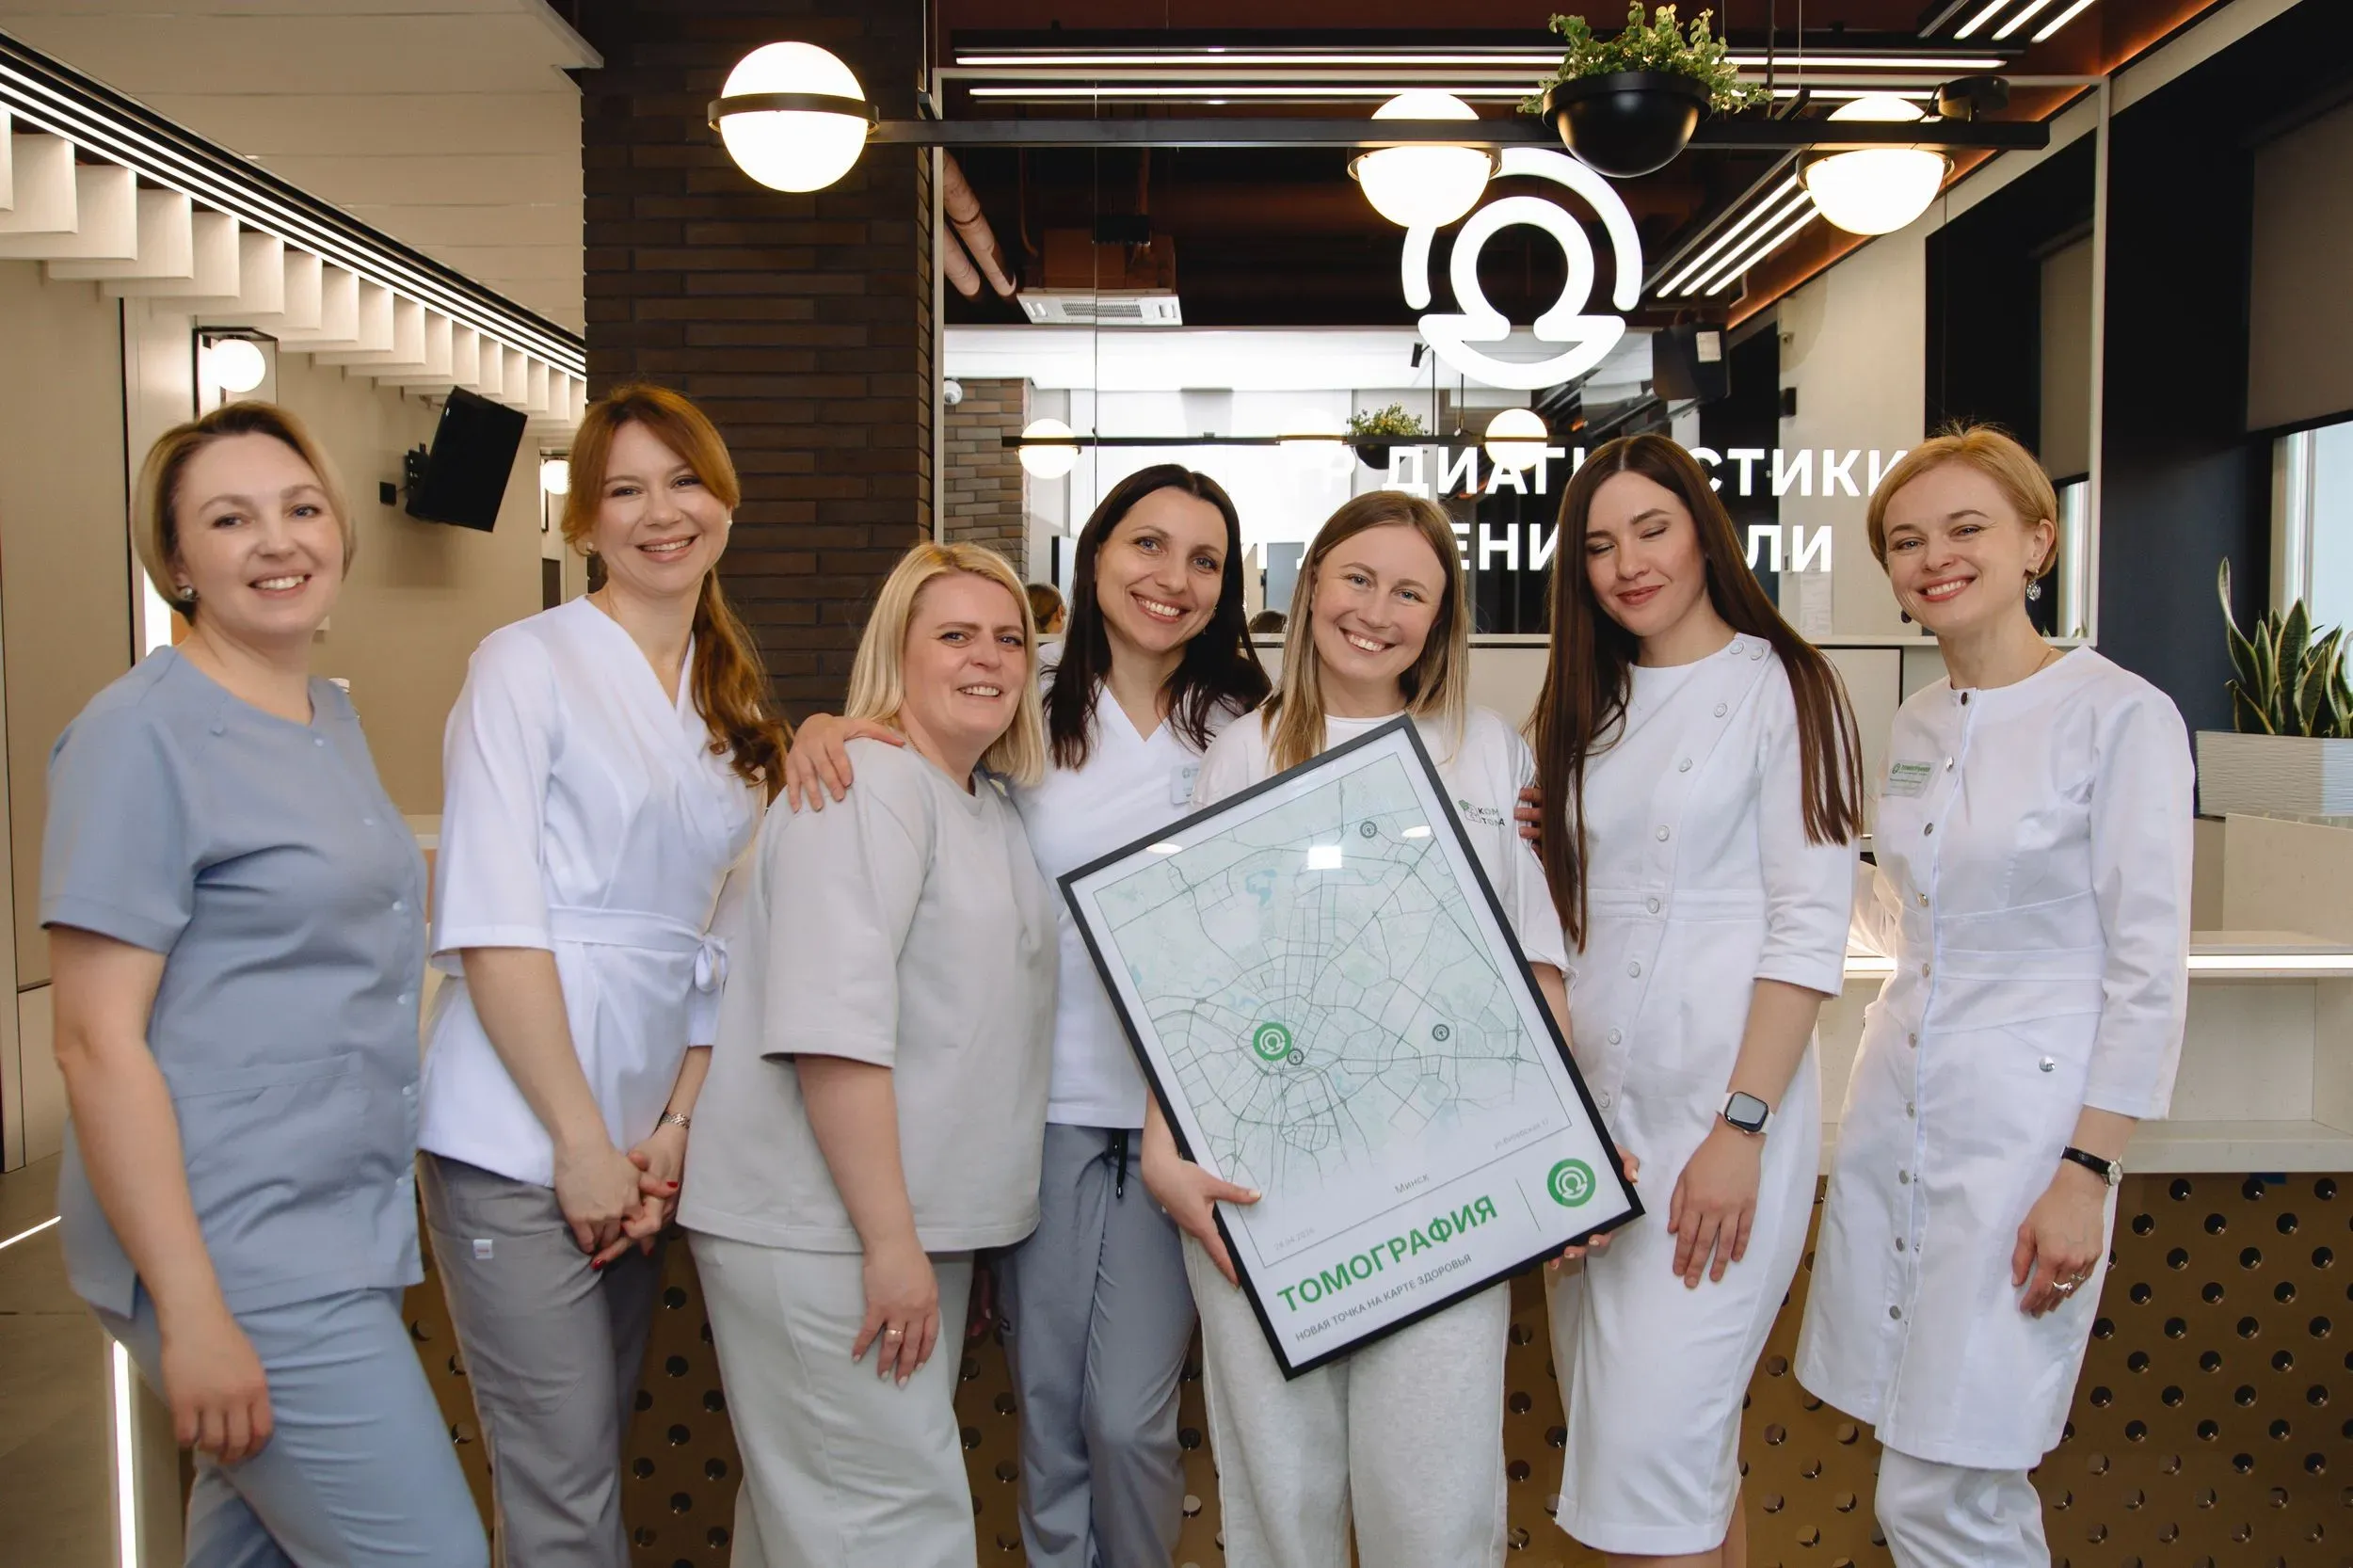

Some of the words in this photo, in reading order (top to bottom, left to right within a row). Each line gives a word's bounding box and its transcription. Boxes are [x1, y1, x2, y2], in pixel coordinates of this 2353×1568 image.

[1381, 445, 1908, 499] ДИАГСТИКИ
[1395, 1175, 1430, 1194] Минск
[1276, 1194, 1497, 1312] ТОМОГРАФИЯ
[1295, 1320, 1331, 1343] НОВАЯ
[1332, 1304, 1367, 1326] ТОЧКА
[1367, 1296, 1383, 1310] НА
[1384, 1279, 1417, 1304] КАРТЕ
[1417, 1253, 1472, 1286] ЗДОРОВЬЯ
